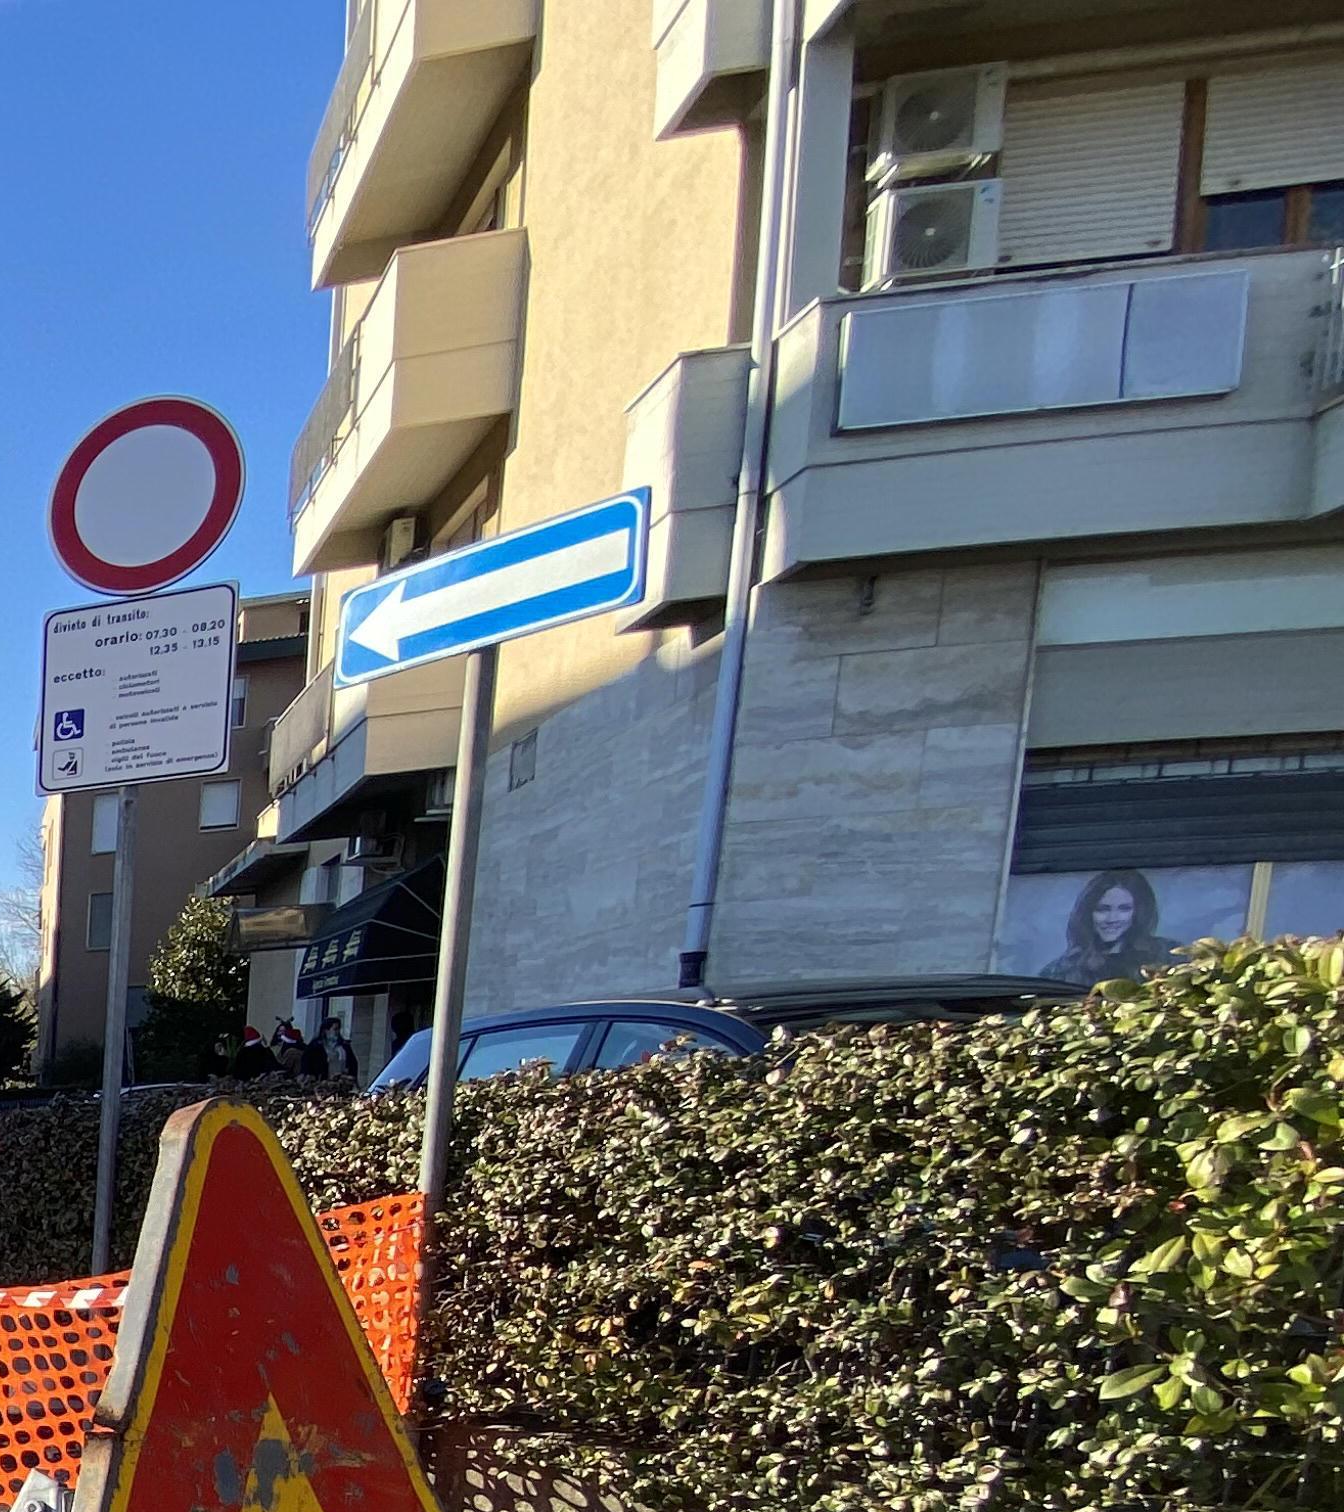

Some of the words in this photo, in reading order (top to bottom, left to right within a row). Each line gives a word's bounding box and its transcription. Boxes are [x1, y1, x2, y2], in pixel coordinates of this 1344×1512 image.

[53, 621, 86, 634] divieto
[91, 616, 101, 628] di
[107, 610, 150, 625] transito:
[95, 631, 143, 648] orario:
[145, 627, 177, 640] 07.30
[191, 619, 225, 633] 08.20
[149, 643, 178, 656] 12.35
[53, 668, 106, 684] eccetto:
